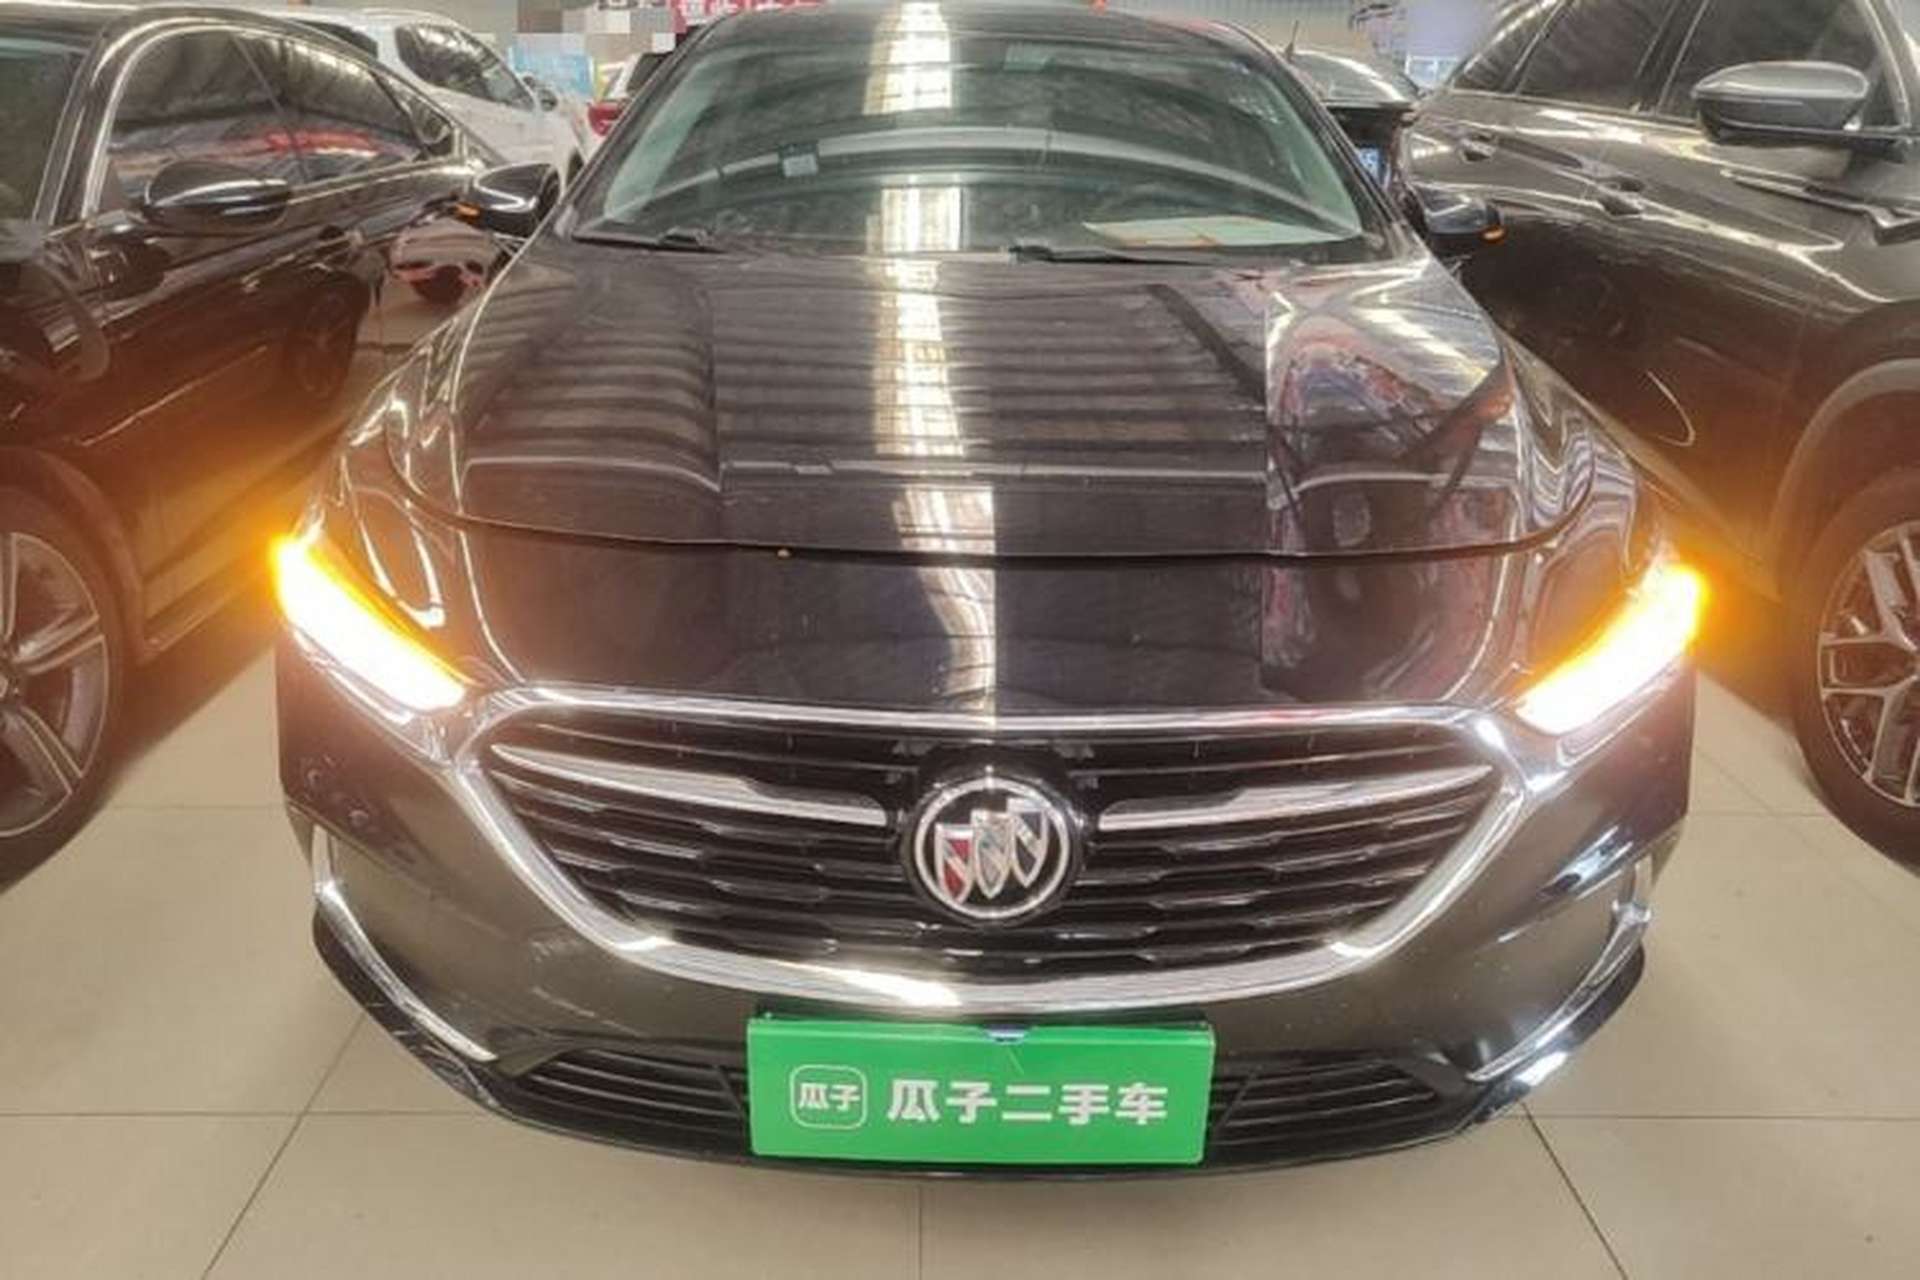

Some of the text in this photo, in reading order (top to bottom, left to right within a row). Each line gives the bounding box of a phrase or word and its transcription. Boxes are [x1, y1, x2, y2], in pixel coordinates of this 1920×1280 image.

[797, 1082, 861, 1111] 瓜子
[886, 1079, 1168, 1126] 瓜子二手车
